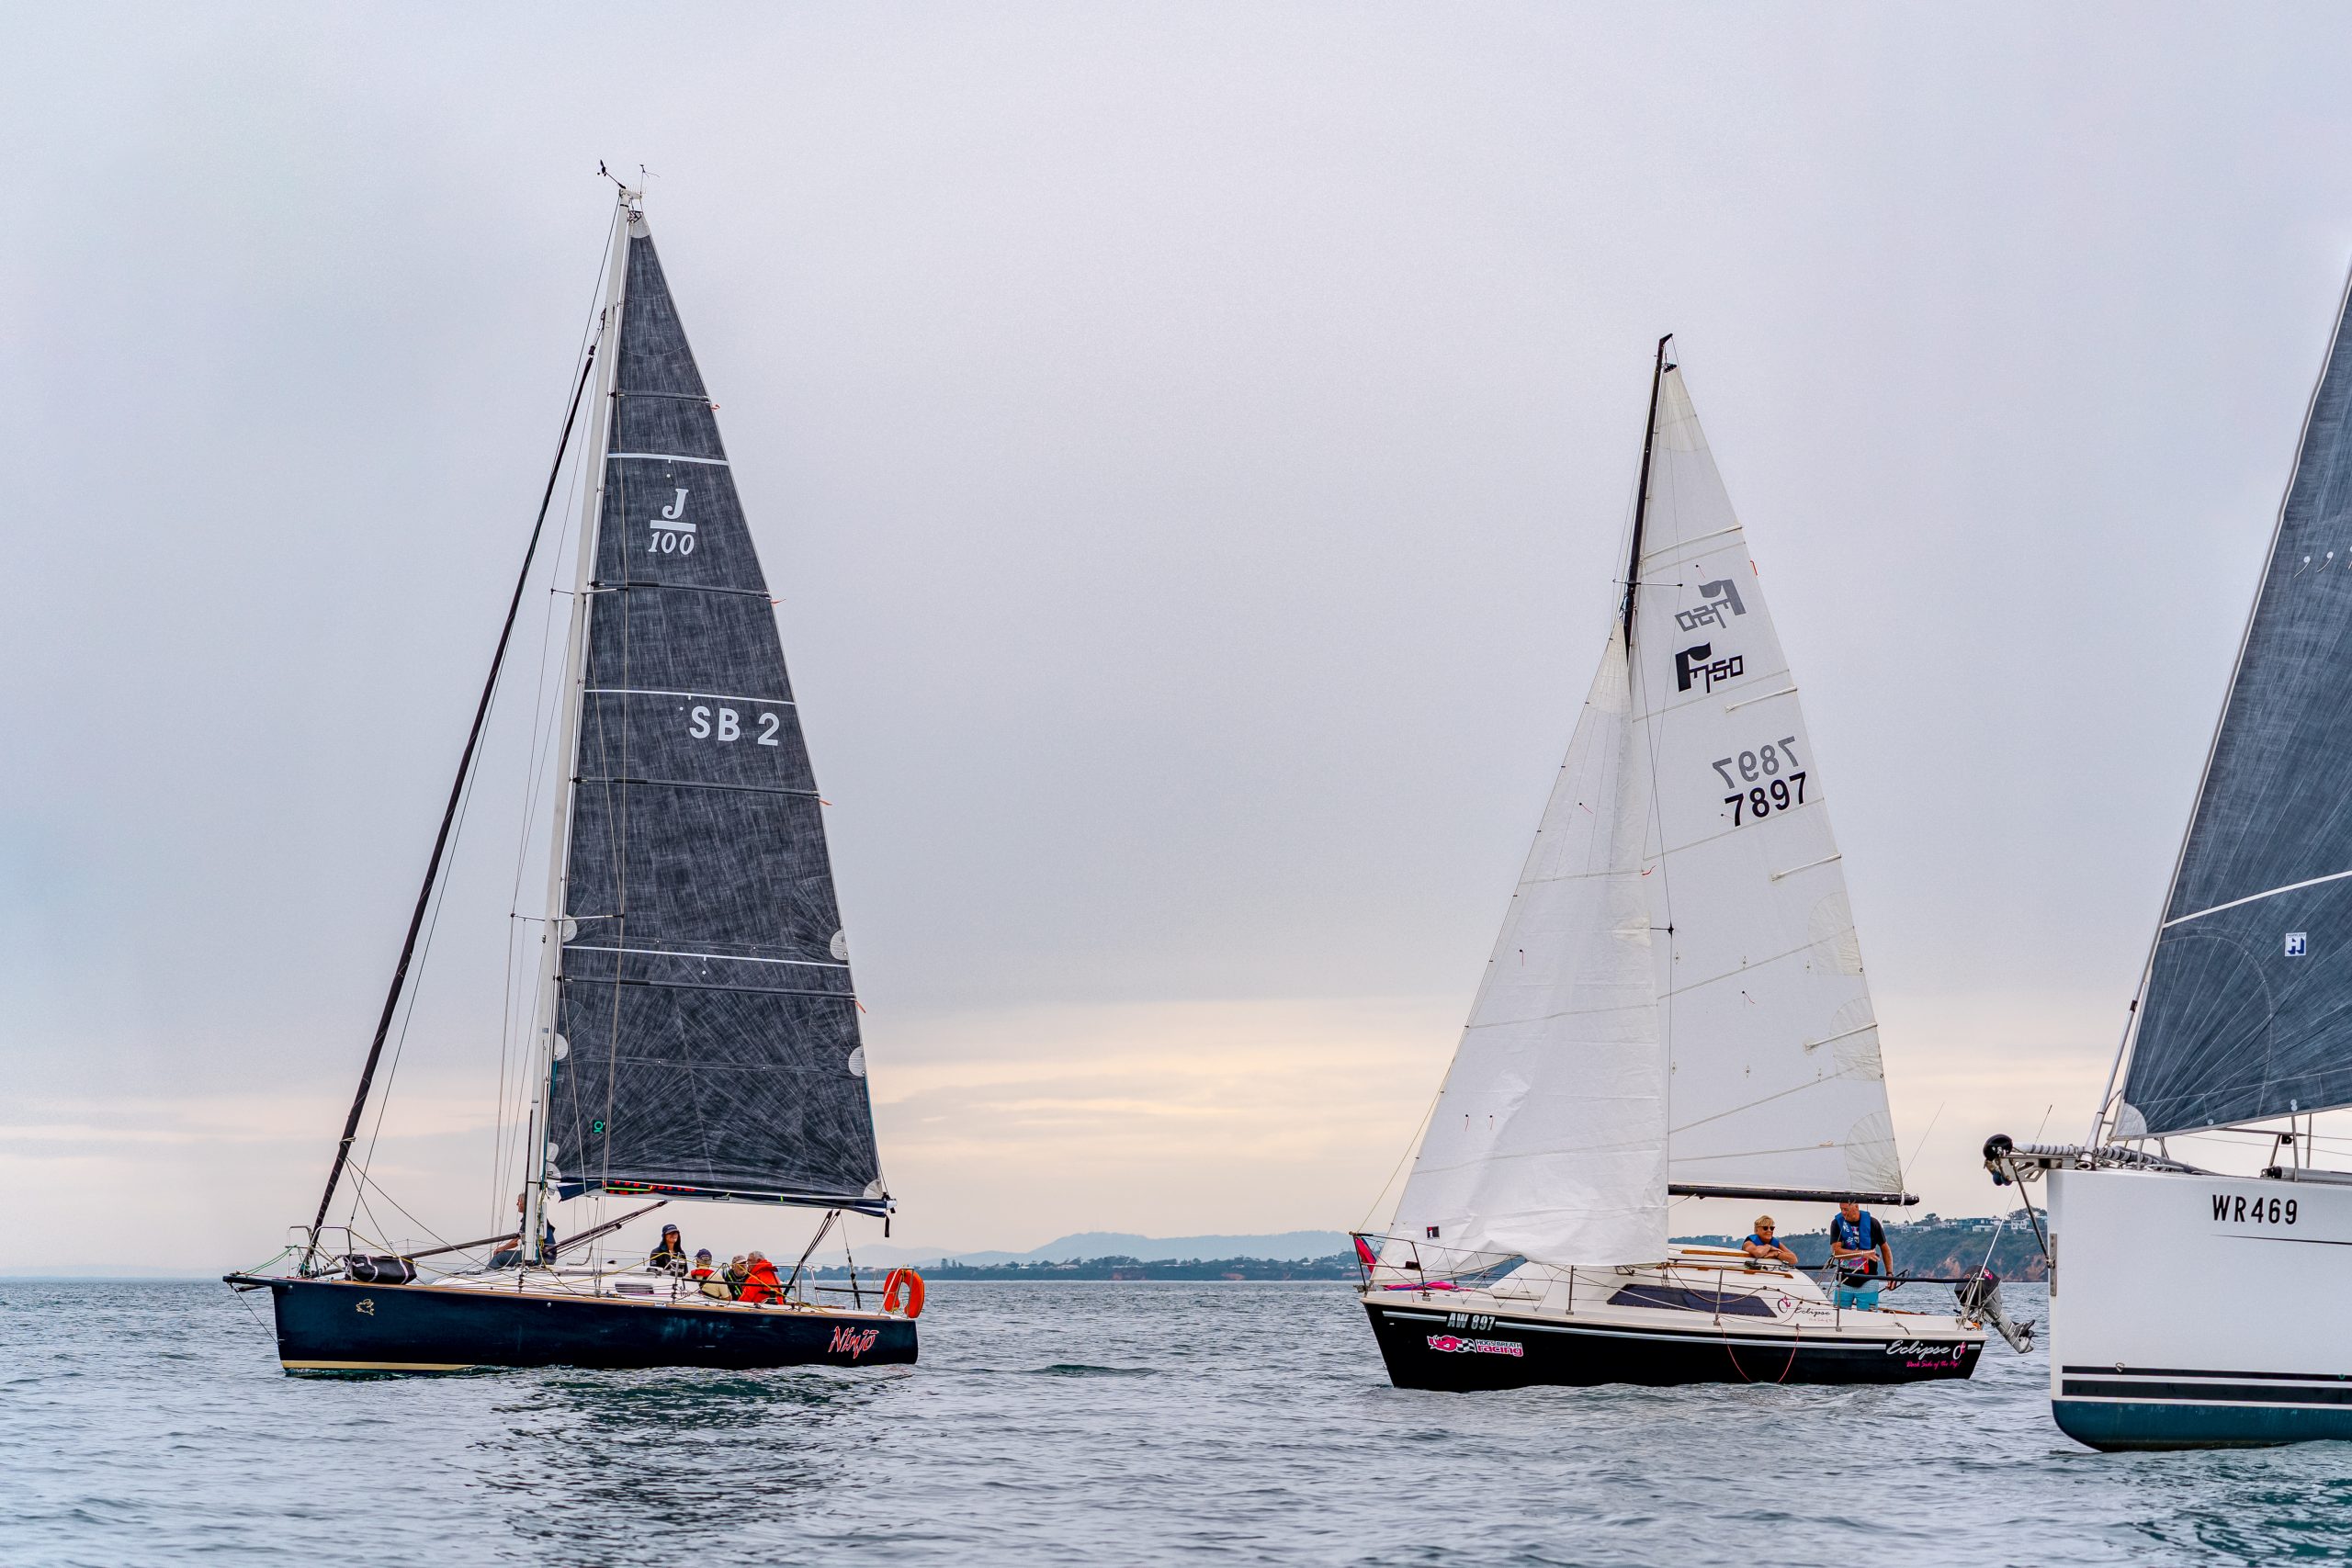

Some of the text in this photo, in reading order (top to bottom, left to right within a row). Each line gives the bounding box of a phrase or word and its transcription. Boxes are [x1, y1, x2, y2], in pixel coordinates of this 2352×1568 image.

[662, 488, 689, 520] J
[648, 531, 695, 556] 100
[689, 705, 780, 746] SB 2
[1724, 771, 1806, 828] 7897
[2212, 1194, 2298, 1225] WR469
[1447, 1313, 1496, 1331] AW 897
[1477, 1345, 1523, 1357] racing
[1886, 1339, 1951, 1360] Eclipse
